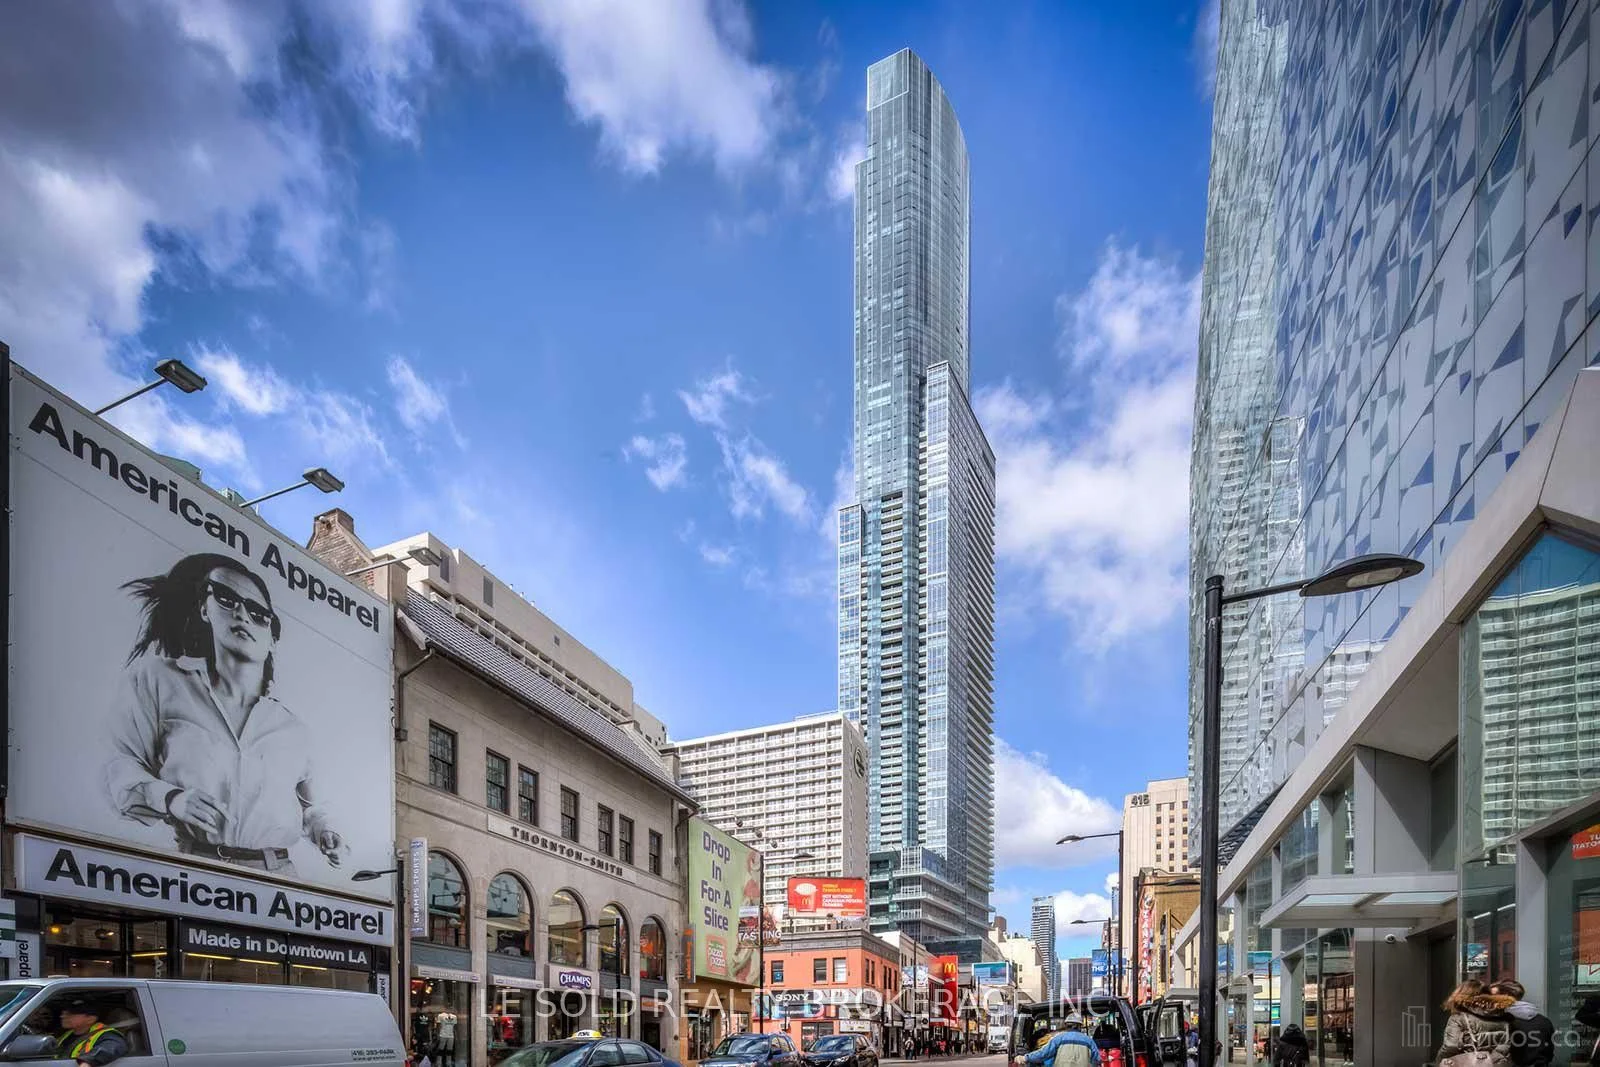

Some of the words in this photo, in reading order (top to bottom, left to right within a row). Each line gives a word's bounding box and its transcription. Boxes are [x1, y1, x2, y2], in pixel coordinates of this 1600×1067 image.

[28, 402, 250, 556] American
[260, 543, 379, 634] Apparel
[511, 826, 623, 876] THORNTON-SMITH
[703, 831, 730, 864] Drop
[712, 860, 721, 881] In
[45, 848, 257, 915] American
[268, 891, 384, 935] Apparel
[701, 880, 720, 903] For
[724, 889, 732, 909] A
[704, 905, 729, 931] Slice
[188, 928, 241, 948] Made
[246, 934, 261, 952] in
[266, 938, 345, 962] Downtown
[348, 949, 368, 965] LA
[738, 929, 781, 941] TASING
[16, 940, 31, 978] pparel
[560, 973, 592, 988] CHAMPS
[775, 993, 809, 1002] SONY
